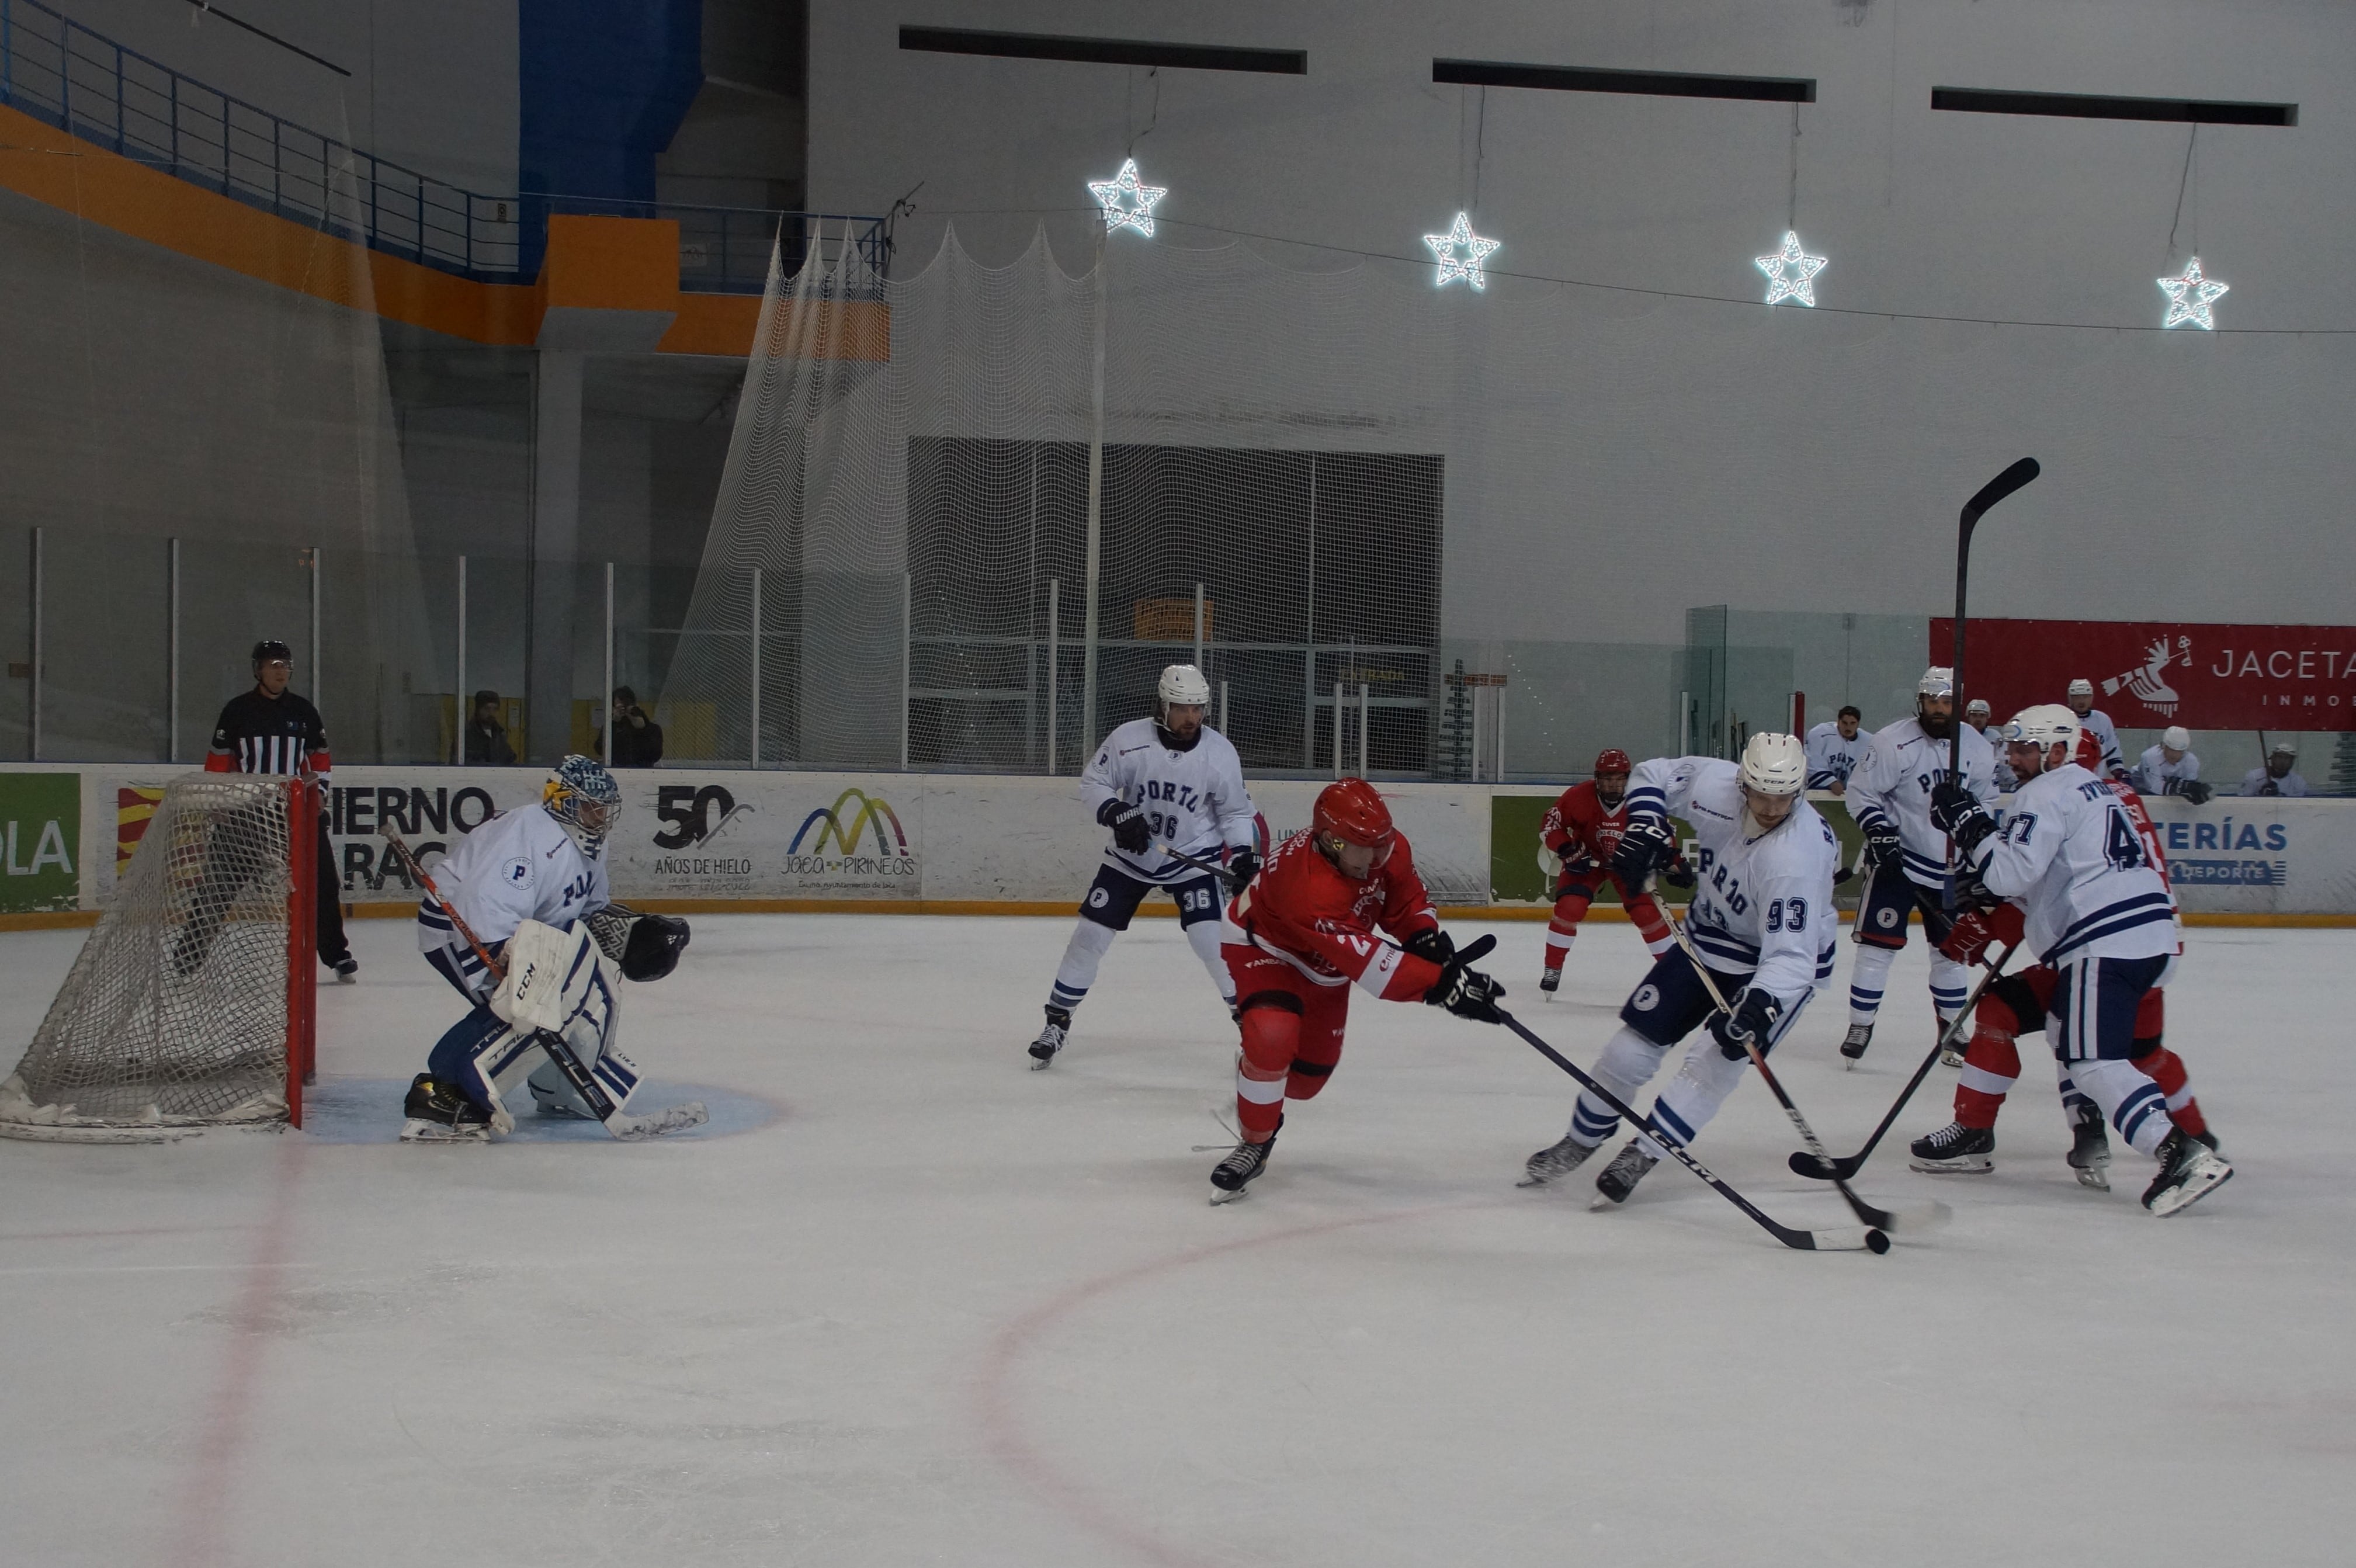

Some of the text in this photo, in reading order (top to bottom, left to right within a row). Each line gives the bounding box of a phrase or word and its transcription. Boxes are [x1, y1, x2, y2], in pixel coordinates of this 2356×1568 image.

[2262, 693, 2356, 706] INMO
[1150, 811, 1179, 841] 36
[0, 820, 73, 876] LA
[655, 856, 752, 875] AÑOS DE HIELO
[844, 858, 914, 875] PIRINEOS
[2182, 866, 2265, 879] DEPORTE
[1182, 888, 1211, 913] 36
[1766, 897, 1808, 934] 93
[516, 962, 536, 1001] CCM
[1647, 1129, 1719, 1184] CCM
